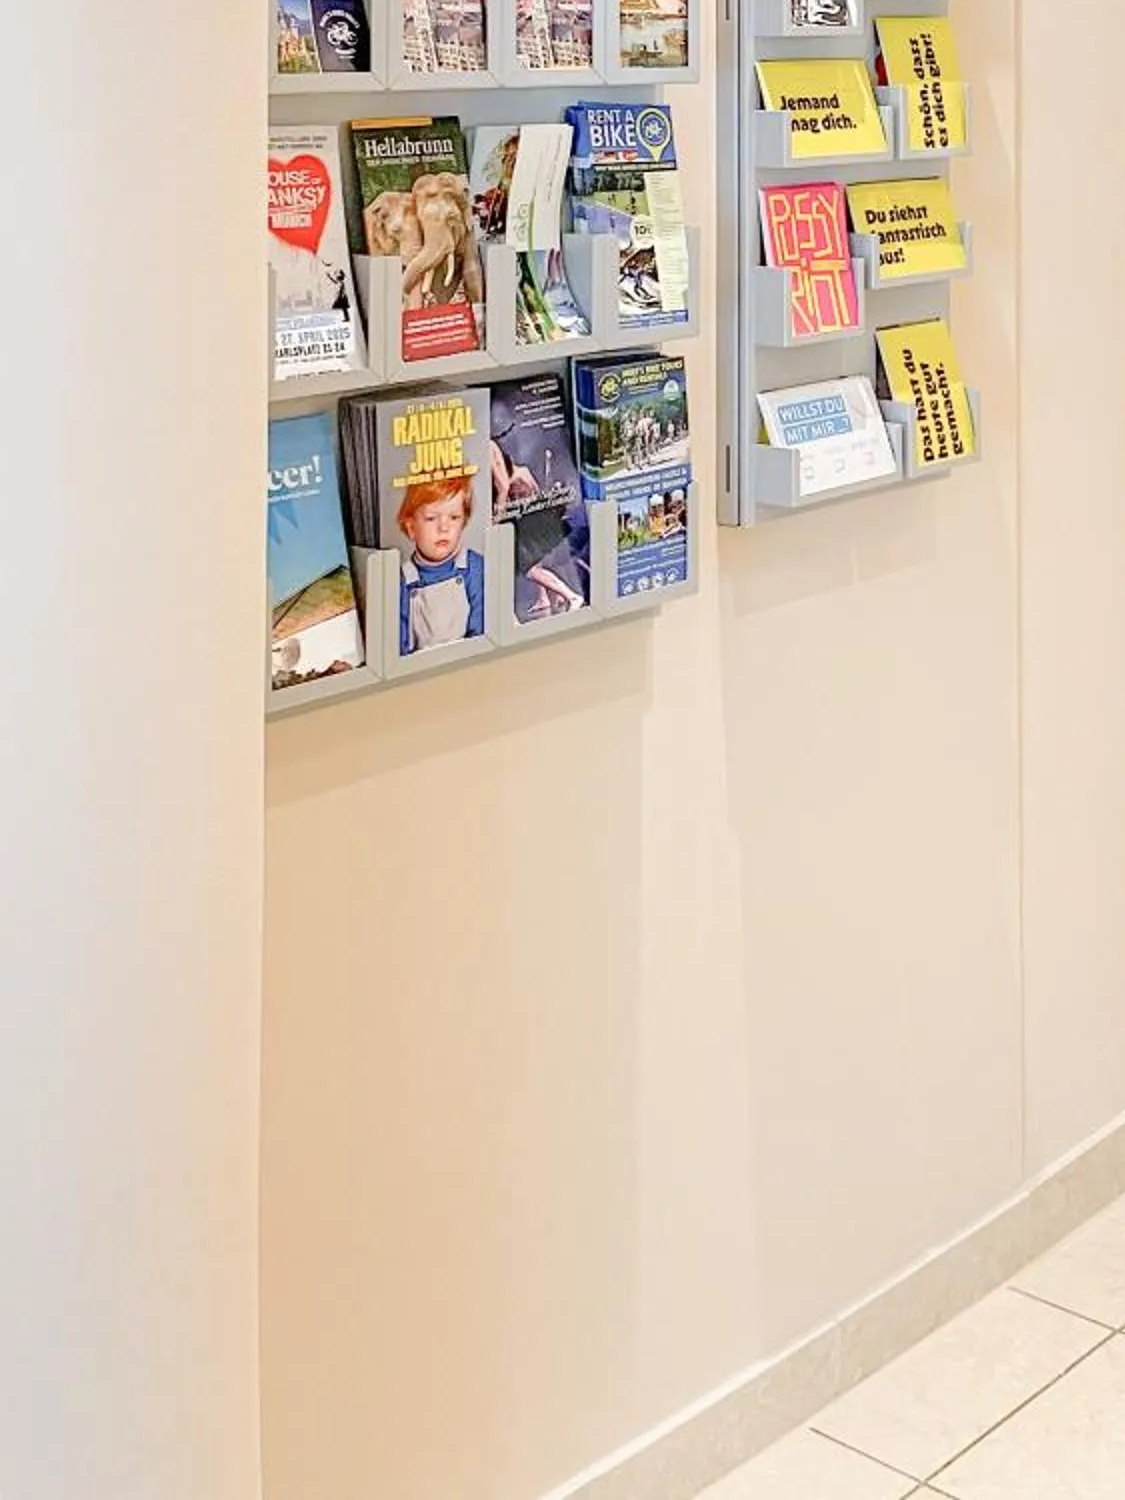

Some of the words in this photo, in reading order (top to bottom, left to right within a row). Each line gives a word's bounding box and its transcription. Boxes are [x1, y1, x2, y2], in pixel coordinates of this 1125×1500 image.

[780, 93, 840, 111] Jemand
[587, 108, 622, 125] RENT
[625, 110, 635, 124] A
[821, 112, 857, 131] dich.
[364, 135, 454, 157] Hellabrunn
[590, 124, 637, 148] BIKE
[268, 170, 309, 187] OUSE
[268, 185, 326, 211] ANKSY
[768, 190, 844, 265] PUSSY
[864, 209, 887, 225] Du
[870, 222, 947, 245] antastisch
[780, 400, 823, 421] WILLST
[825, 398, 844, 413] DU
[393, 405, 477, 447] RADIKAL
[785, 425, 809, 442] MIT
[811, 420, 835, 437] MIR
[921, 425, 935, 462] Das
[410, 438, 463, 473] JUNG
